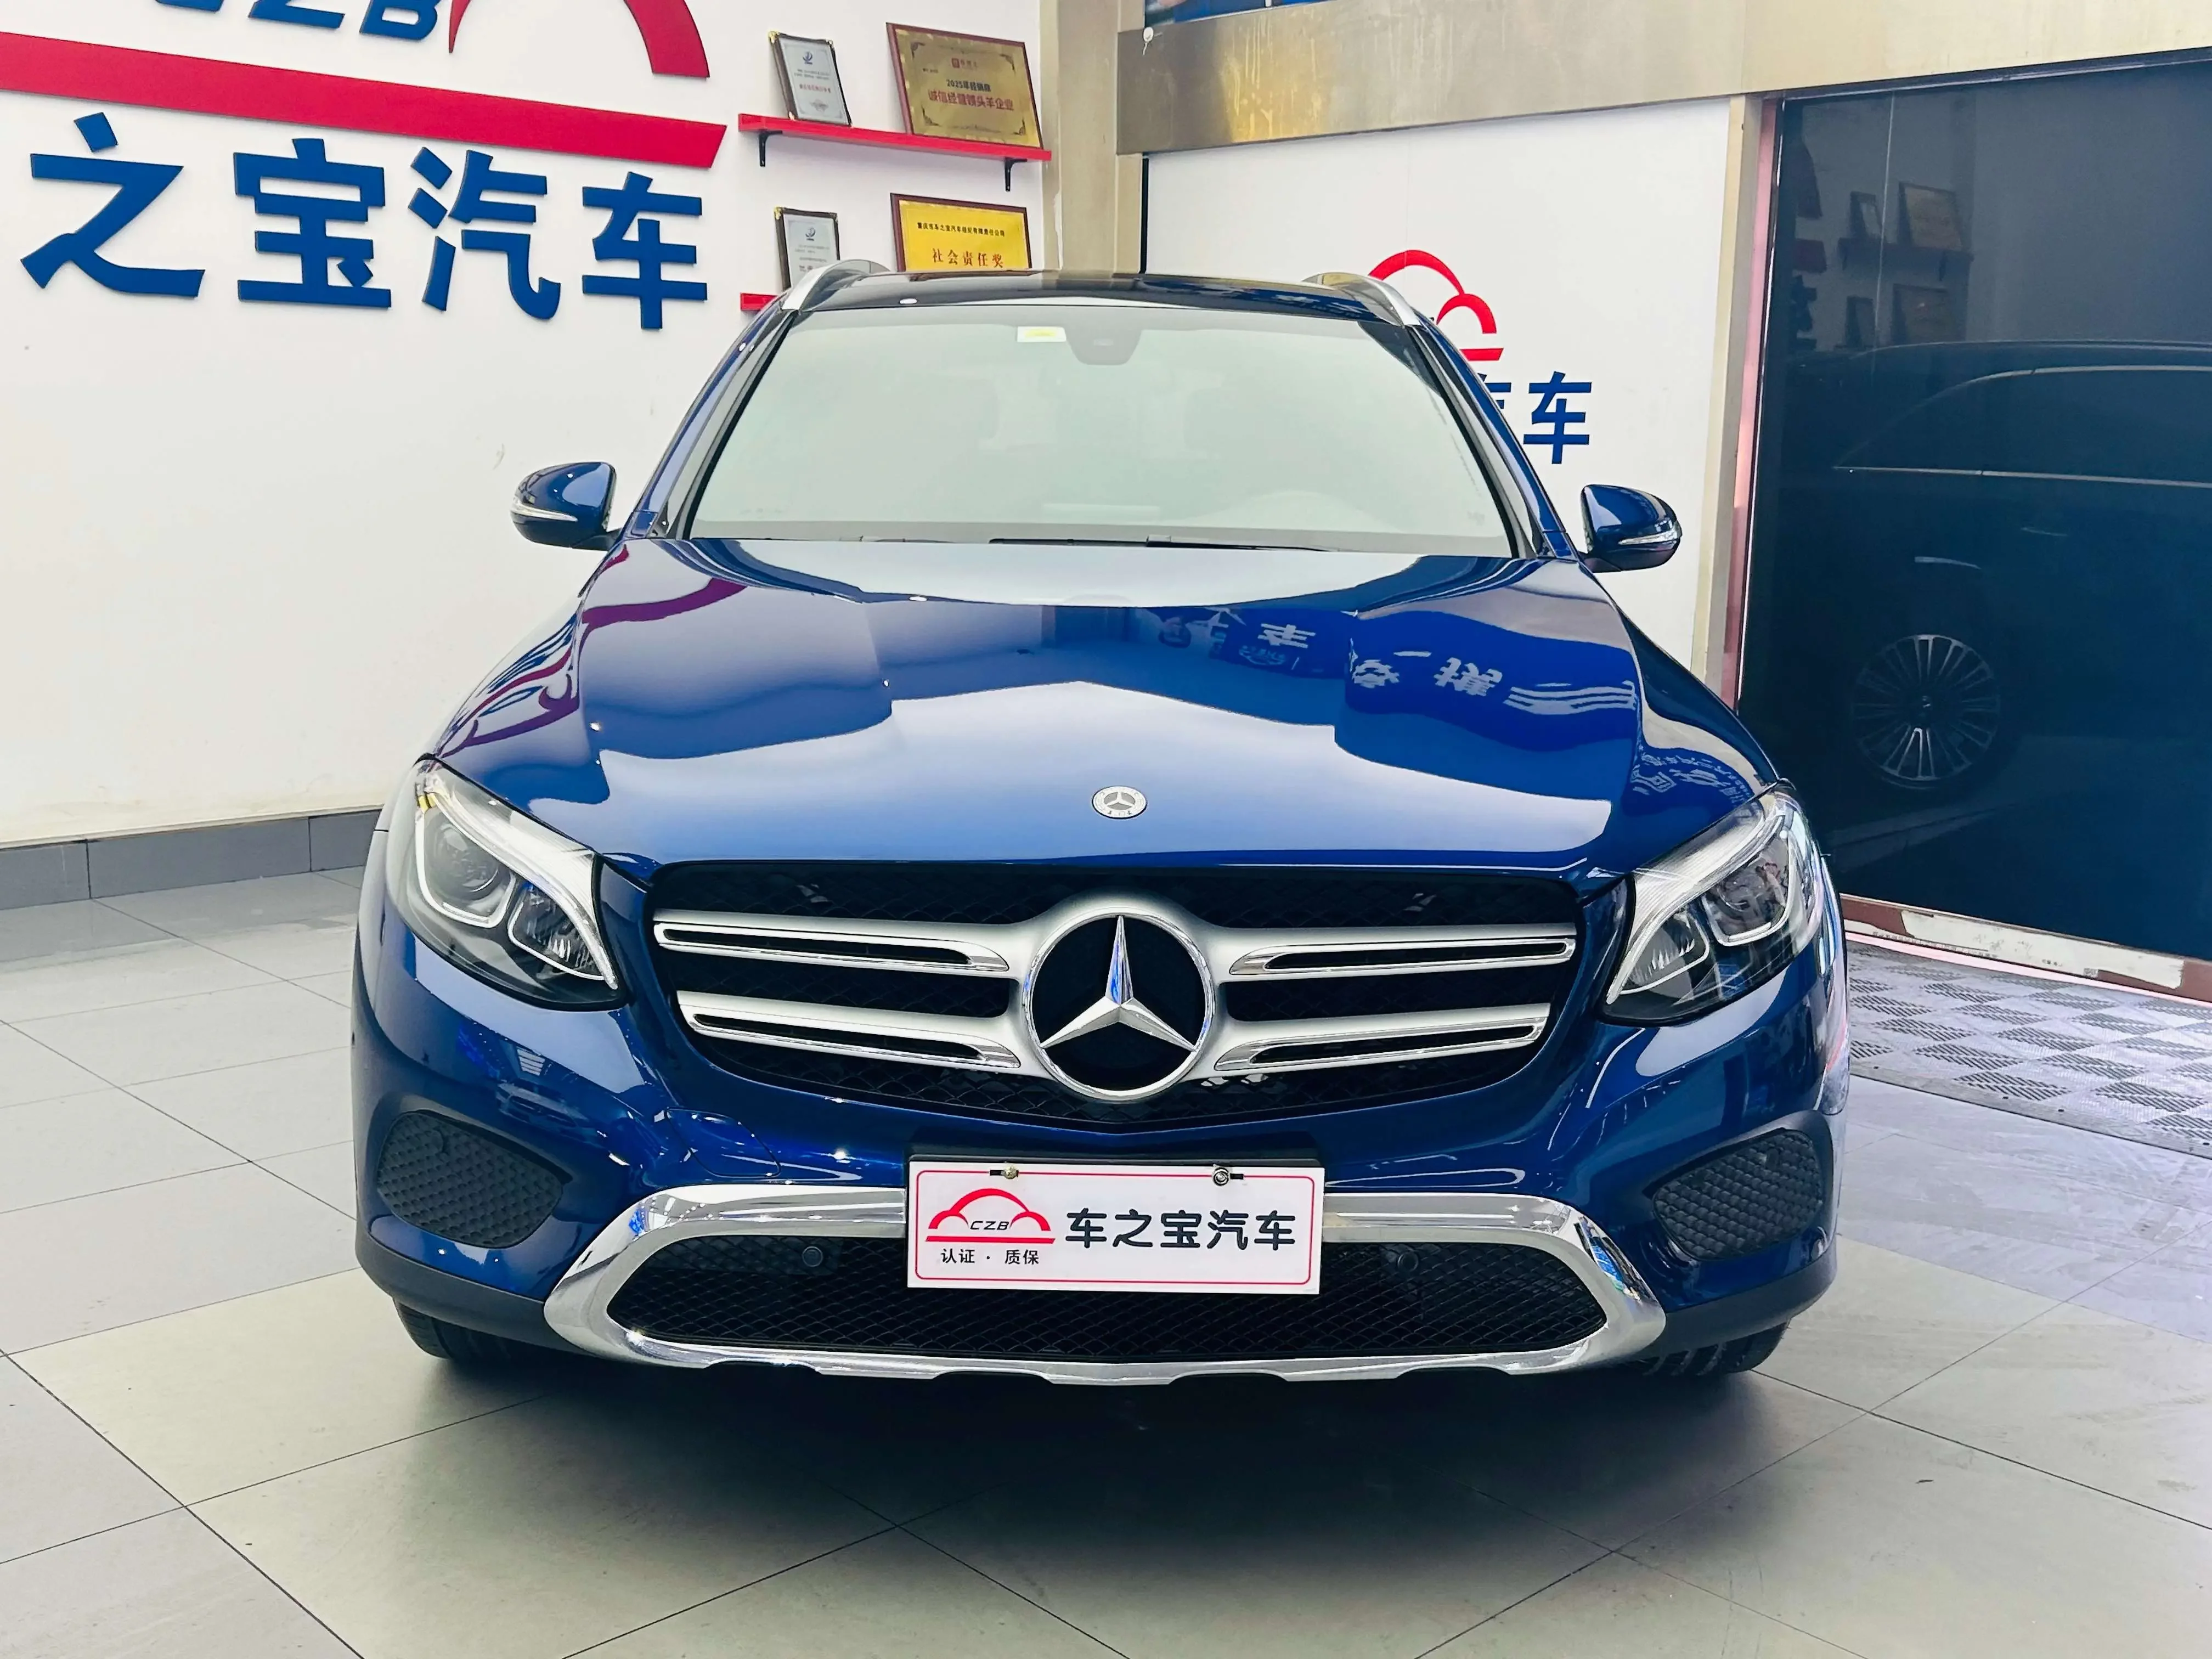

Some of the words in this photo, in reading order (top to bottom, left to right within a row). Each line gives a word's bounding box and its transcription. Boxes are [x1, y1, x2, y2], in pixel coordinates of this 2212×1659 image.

[21, 112, 708, 331] 之宝汽车
[932, 248, 1003, 268] 社会责任奖
[970, 1221, 1009, 1231] CZB
[1065, 1208, 1295, 1251] 车之宝汽车
